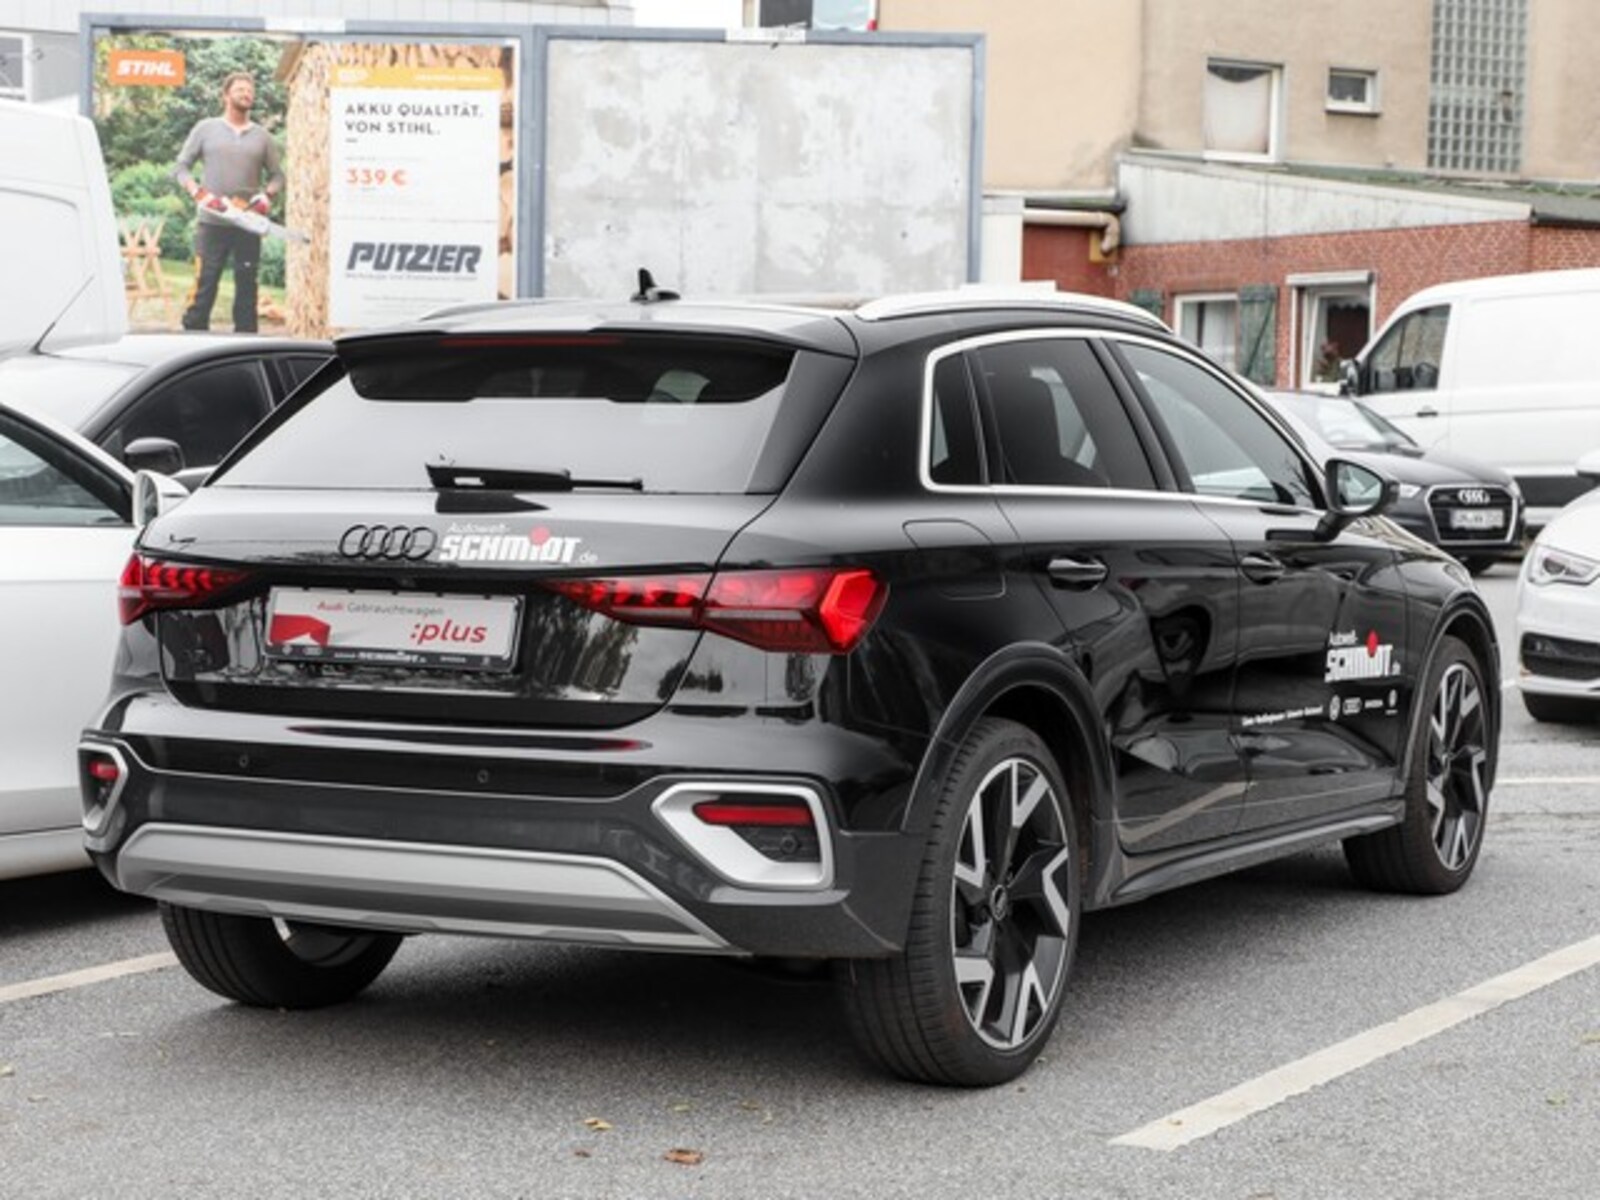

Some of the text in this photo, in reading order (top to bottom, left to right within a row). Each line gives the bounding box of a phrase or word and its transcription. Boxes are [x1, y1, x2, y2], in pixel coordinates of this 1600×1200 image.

[117, 60, 176, 76] STIHL
[345, 101, 484, 118] AKKU QUALITÄT.
[345, 121, 441, 135] VON STIHL.
[346, 168, 408, 186] 339 €
[346, 242, 482, 273] PUTZIER
[438, 527, 582, 563] SCHMIDT
[317, 601, 444, 617] Audi Gebrauchtwagen
[410, 619, 488, 645] :plus
